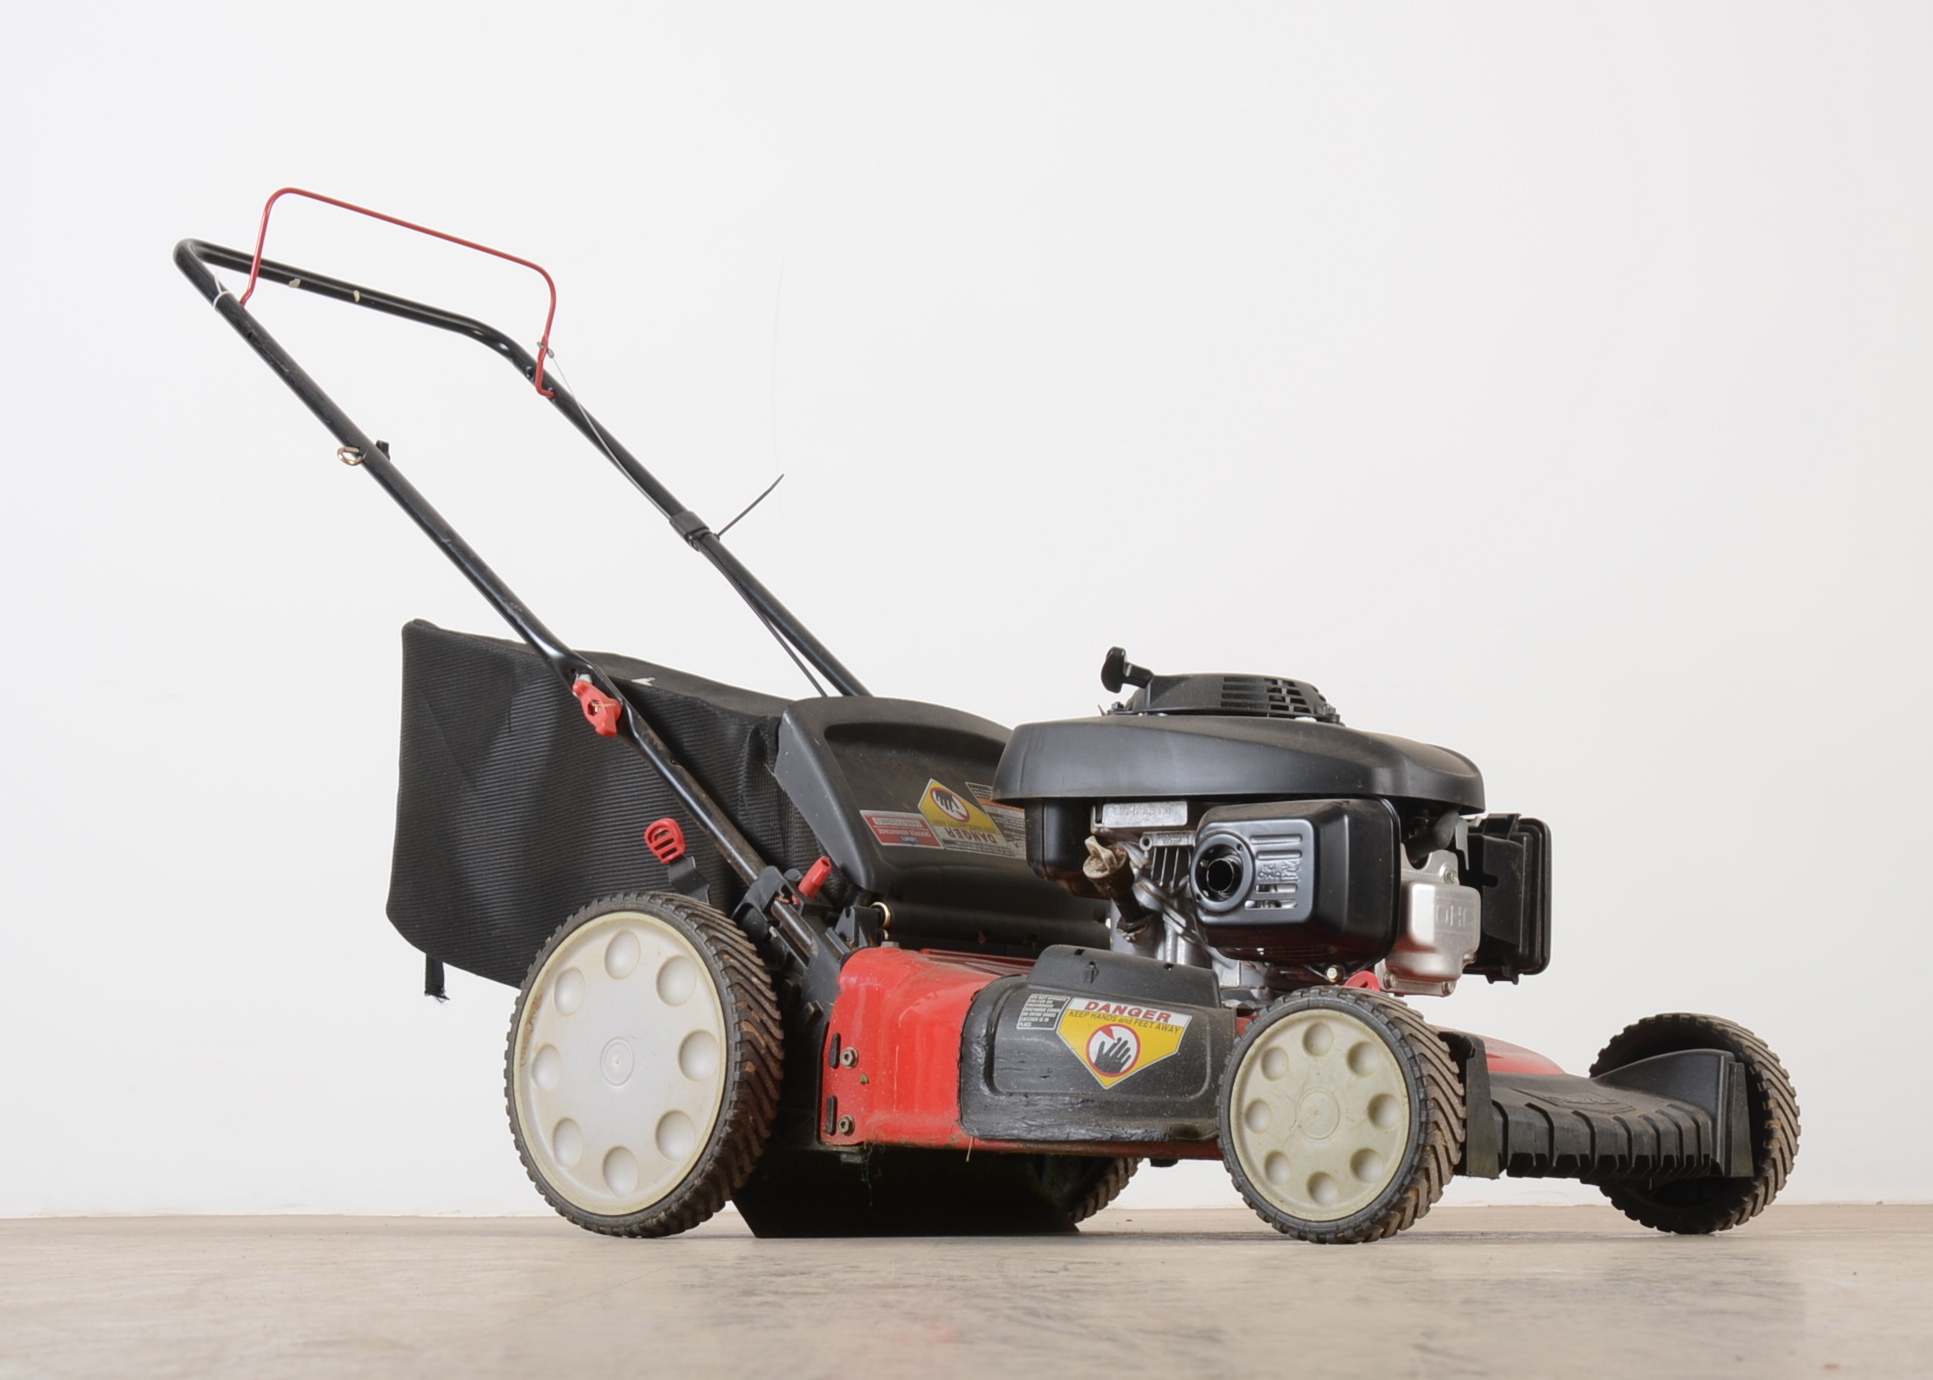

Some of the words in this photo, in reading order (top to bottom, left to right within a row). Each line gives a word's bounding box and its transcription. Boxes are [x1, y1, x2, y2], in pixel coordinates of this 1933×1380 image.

[945, 827, 997, 844] DANGER
[1068, 1010, 1088, 1018] KEEP
[1090, 1012, 1117, 1022] HANDS
[1118, 1016, 1133, 1026] and
[1133, 1019, 1154, 1029] FEET
[1155, 1023, 1181, 1035] AWAY
[1084, 1001, 1172, 1023] DANGER
